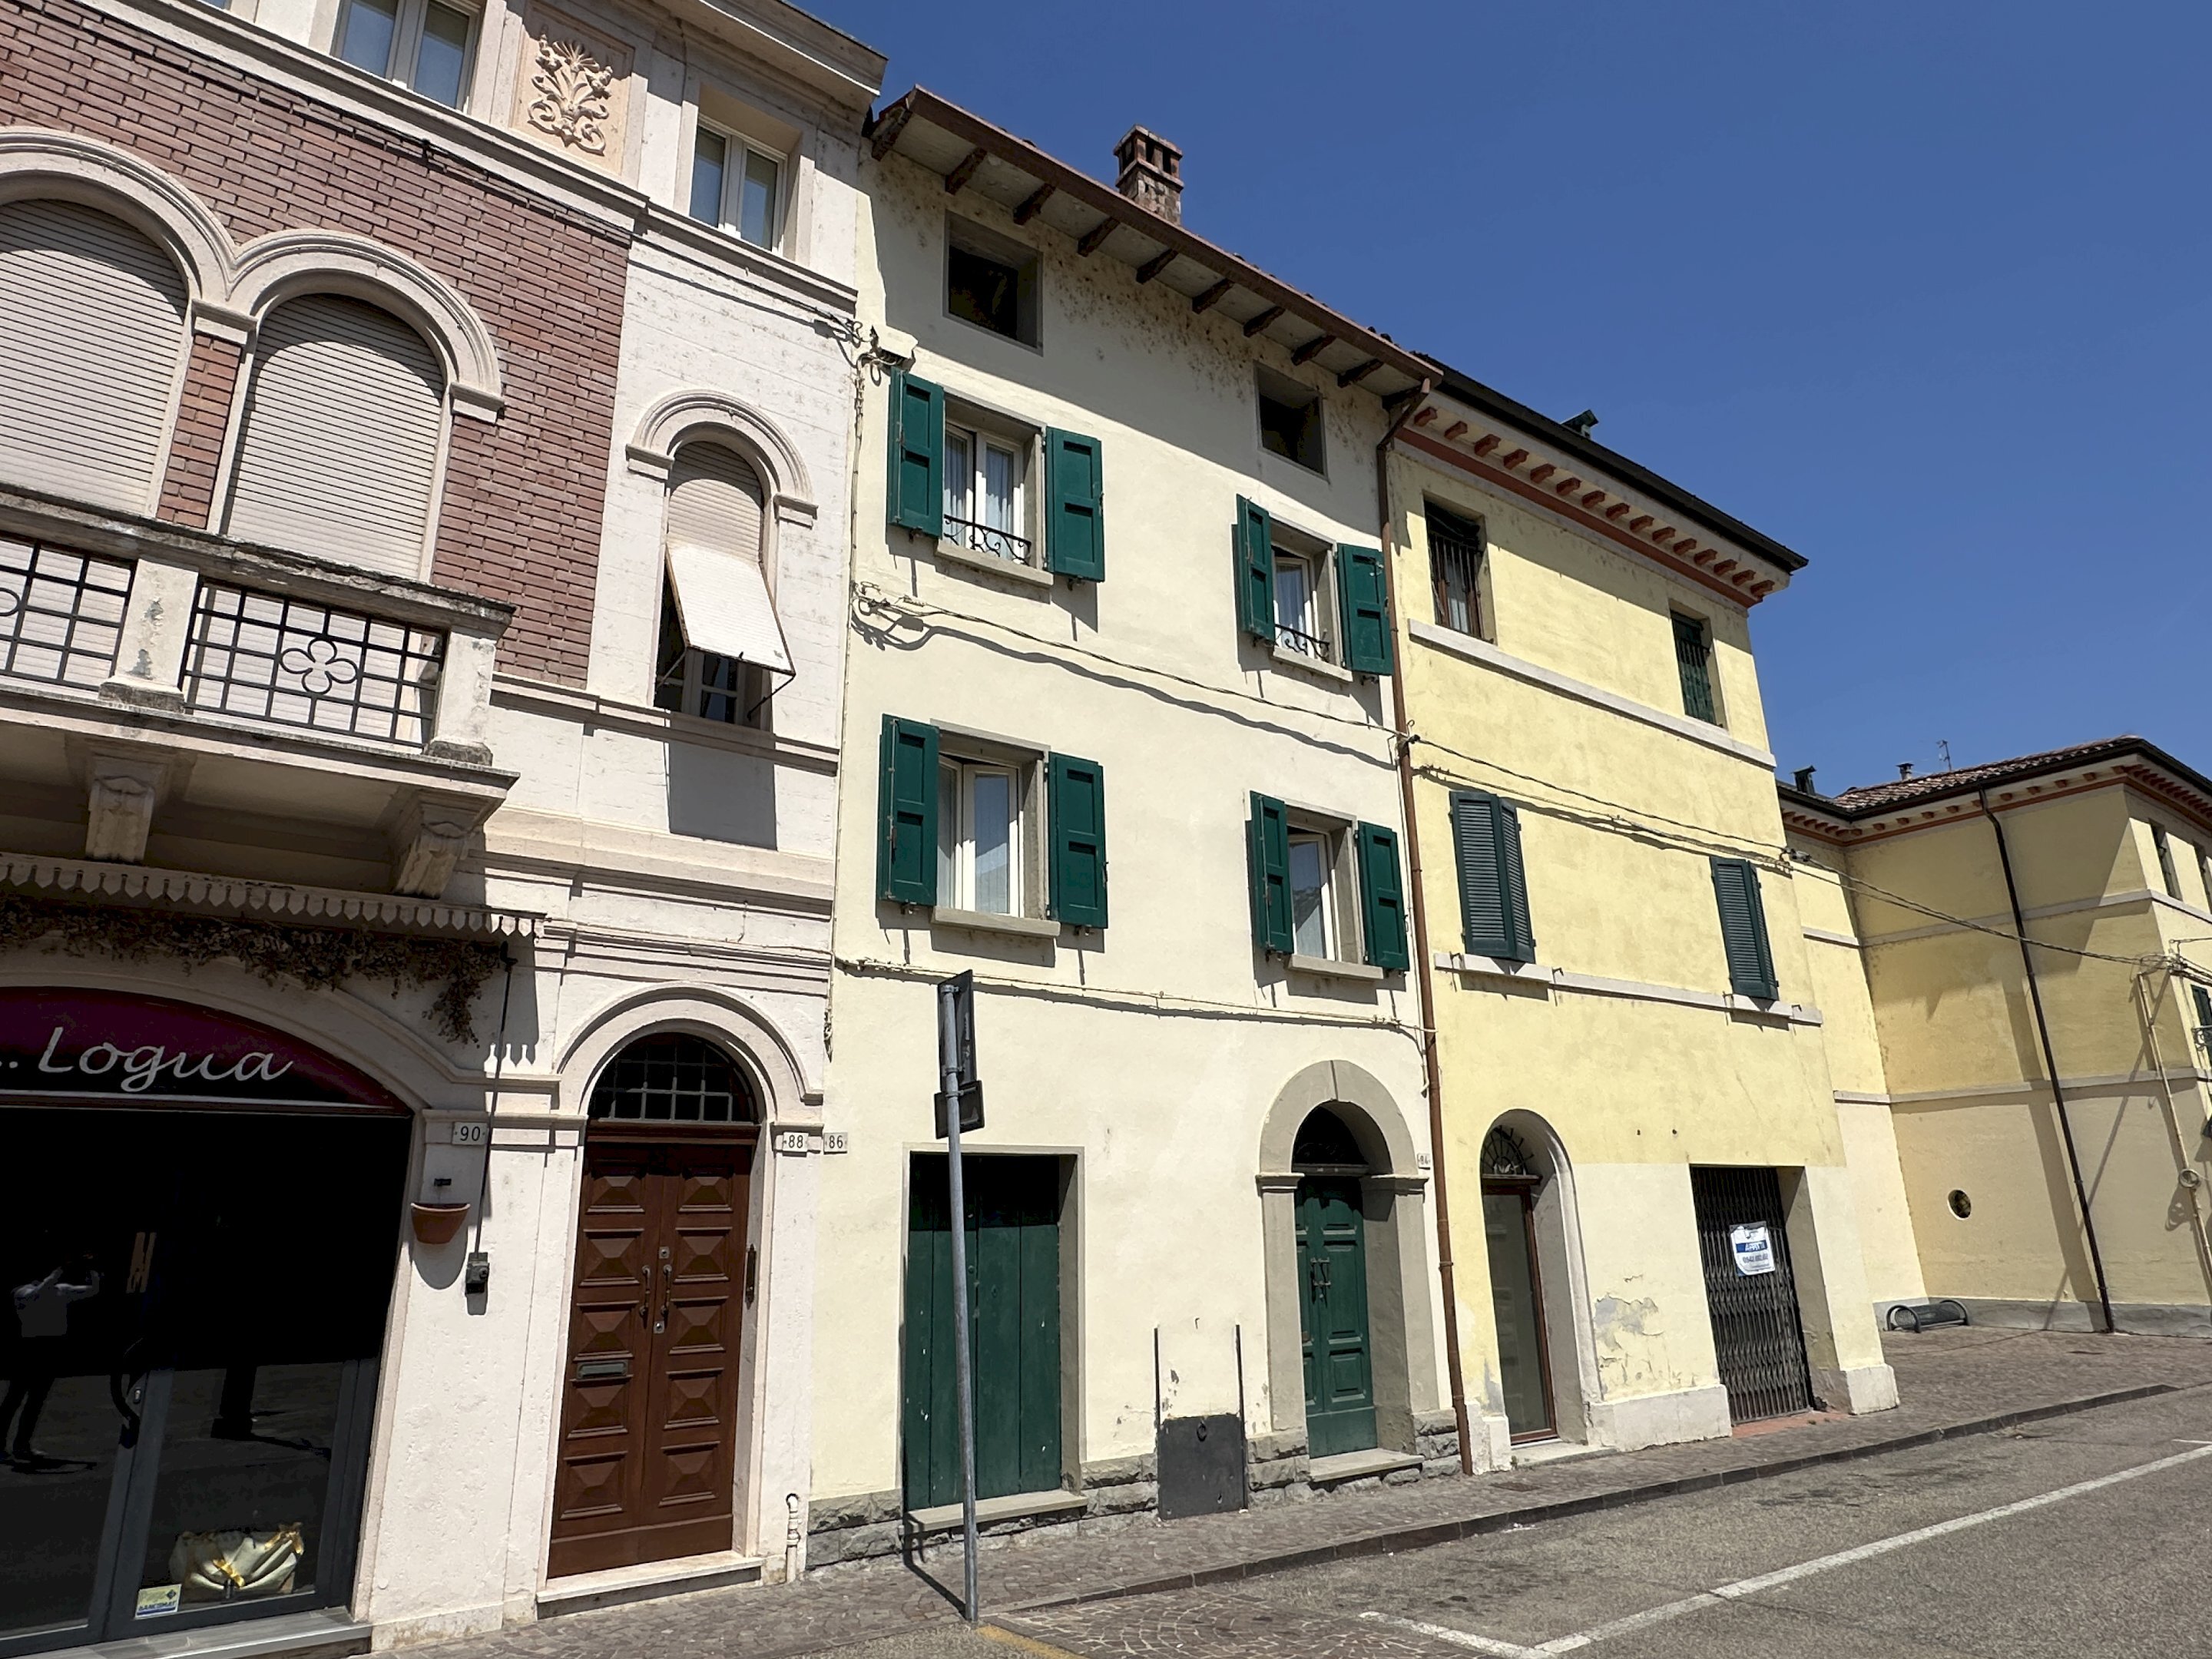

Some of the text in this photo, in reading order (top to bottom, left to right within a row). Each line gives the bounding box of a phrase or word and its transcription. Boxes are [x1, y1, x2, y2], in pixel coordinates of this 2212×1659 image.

[460, 1125, 481, 1141] 90
[788, 1134, 803, 1149] 88
[829, 1134, 843, 1149] 86
